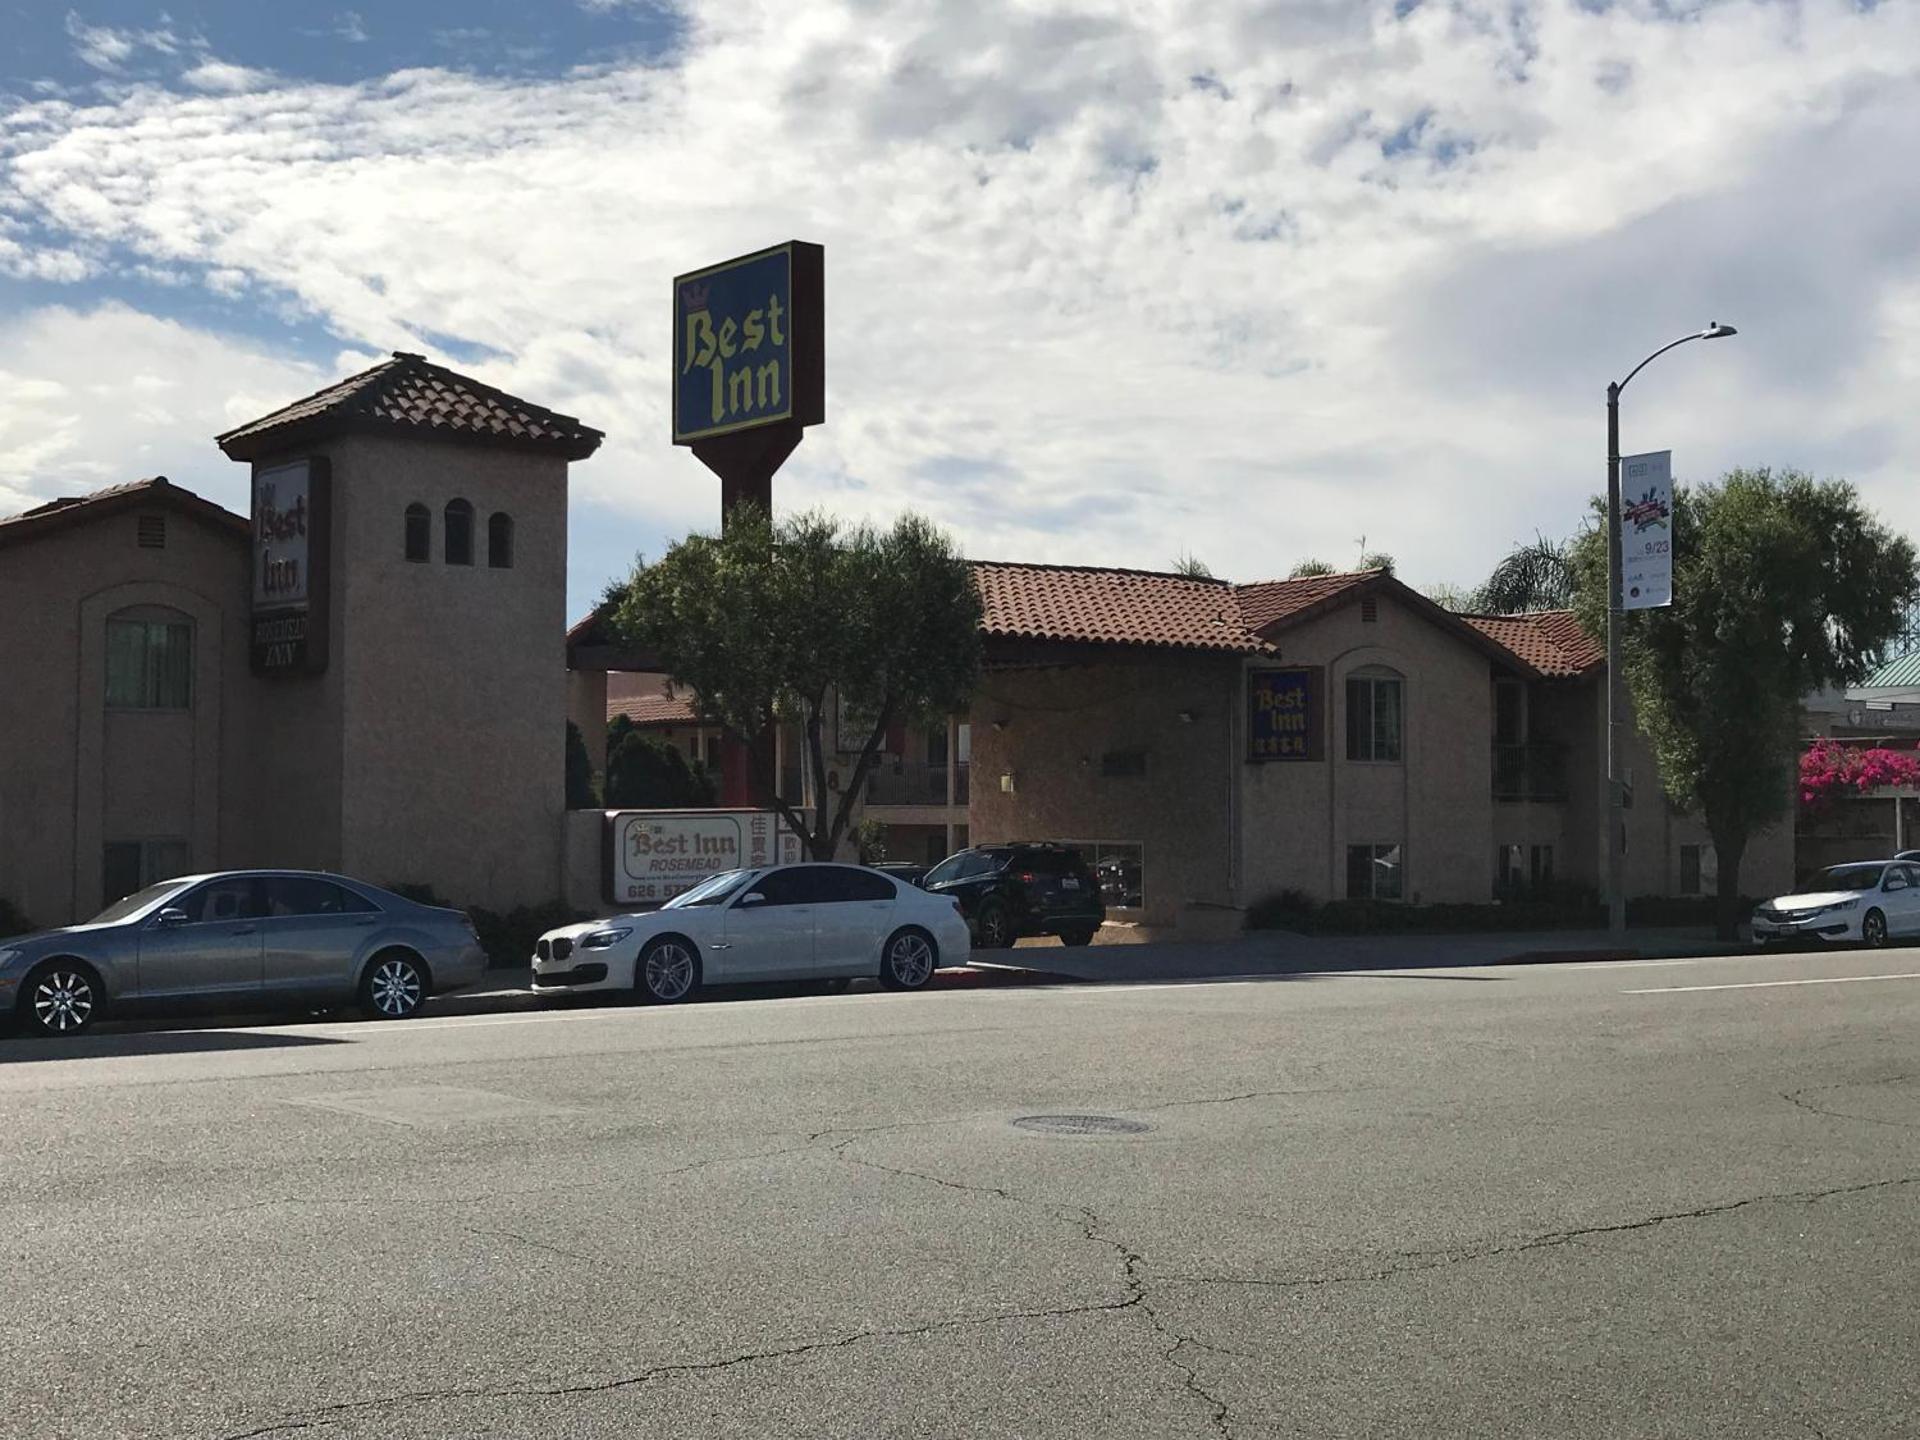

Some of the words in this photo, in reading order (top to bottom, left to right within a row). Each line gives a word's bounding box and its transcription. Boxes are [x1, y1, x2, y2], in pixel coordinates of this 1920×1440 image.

[682, 293, 785, 375] Best
[711, 356, 781, 423] Inn
[259, 495, 305, 543] Best
[1645, 541, 1670, 555] 9/23
[1256, 687, 1305, 711] Best
[1271, 710, 1305, 730] Inn
[631, 833, 689, 857] Best
[695, 833, 736, 856] Inn
[649, 857, 721, 872] ROSEMEAD
